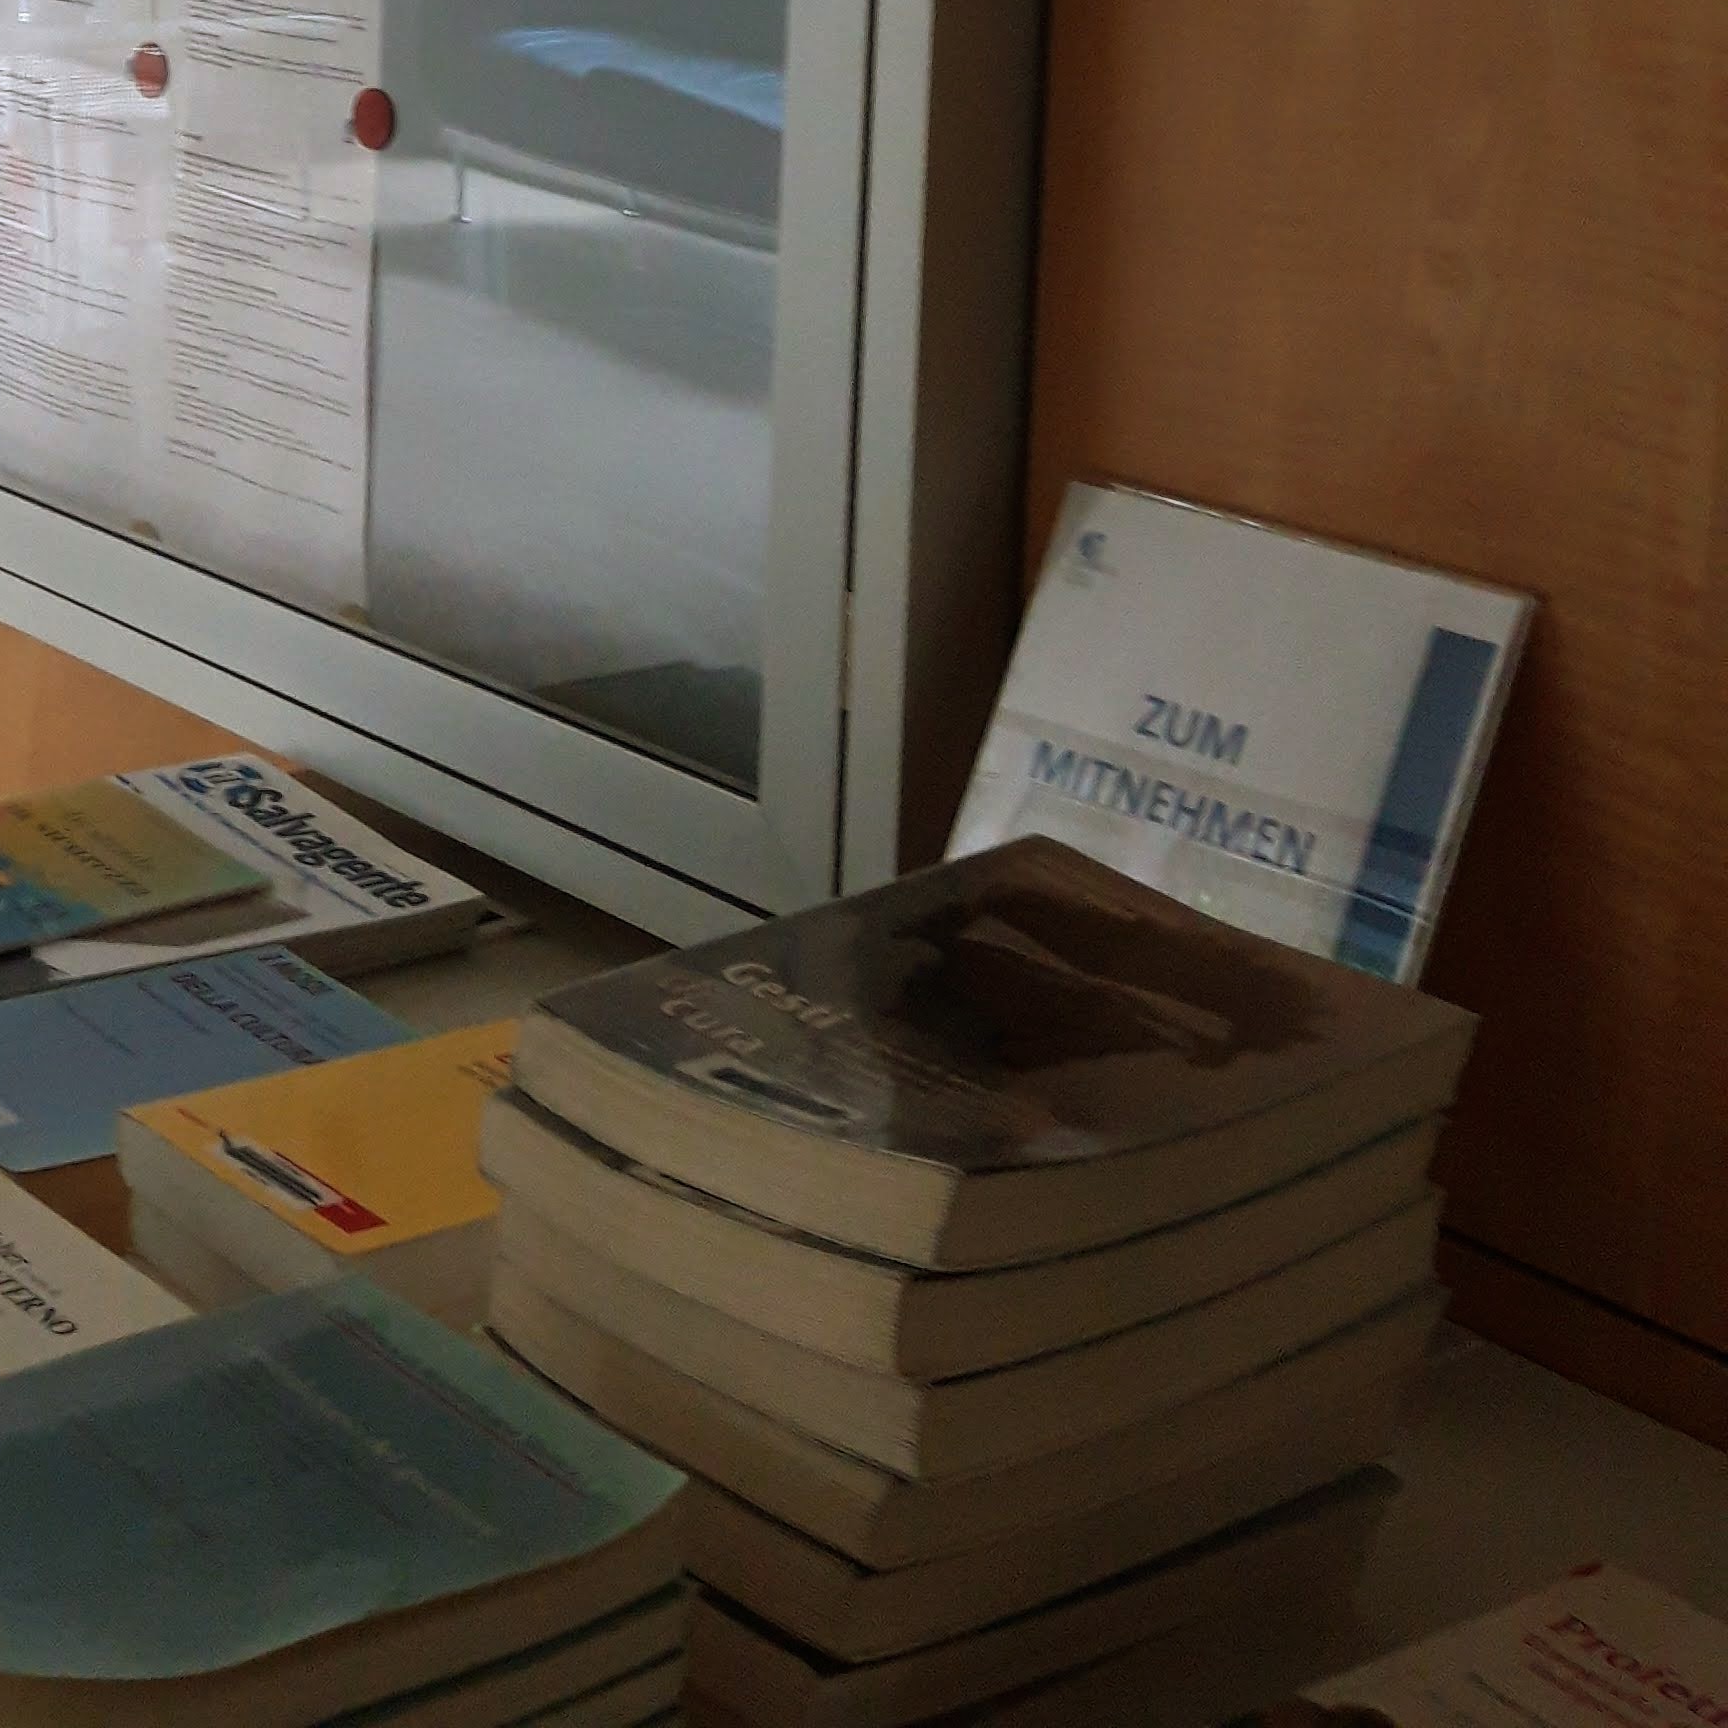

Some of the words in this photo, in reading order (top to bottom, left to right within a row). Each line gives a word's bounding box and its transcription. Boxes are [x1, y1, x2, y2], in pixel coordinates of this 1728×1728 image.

[1133, 692, 1249, 766] ZUM
[225, 784, 430, 908] Salvagente
[1028, 739, 1316, 875] MITNEHMEN
[721, 962, 853, 1030] Gesti
